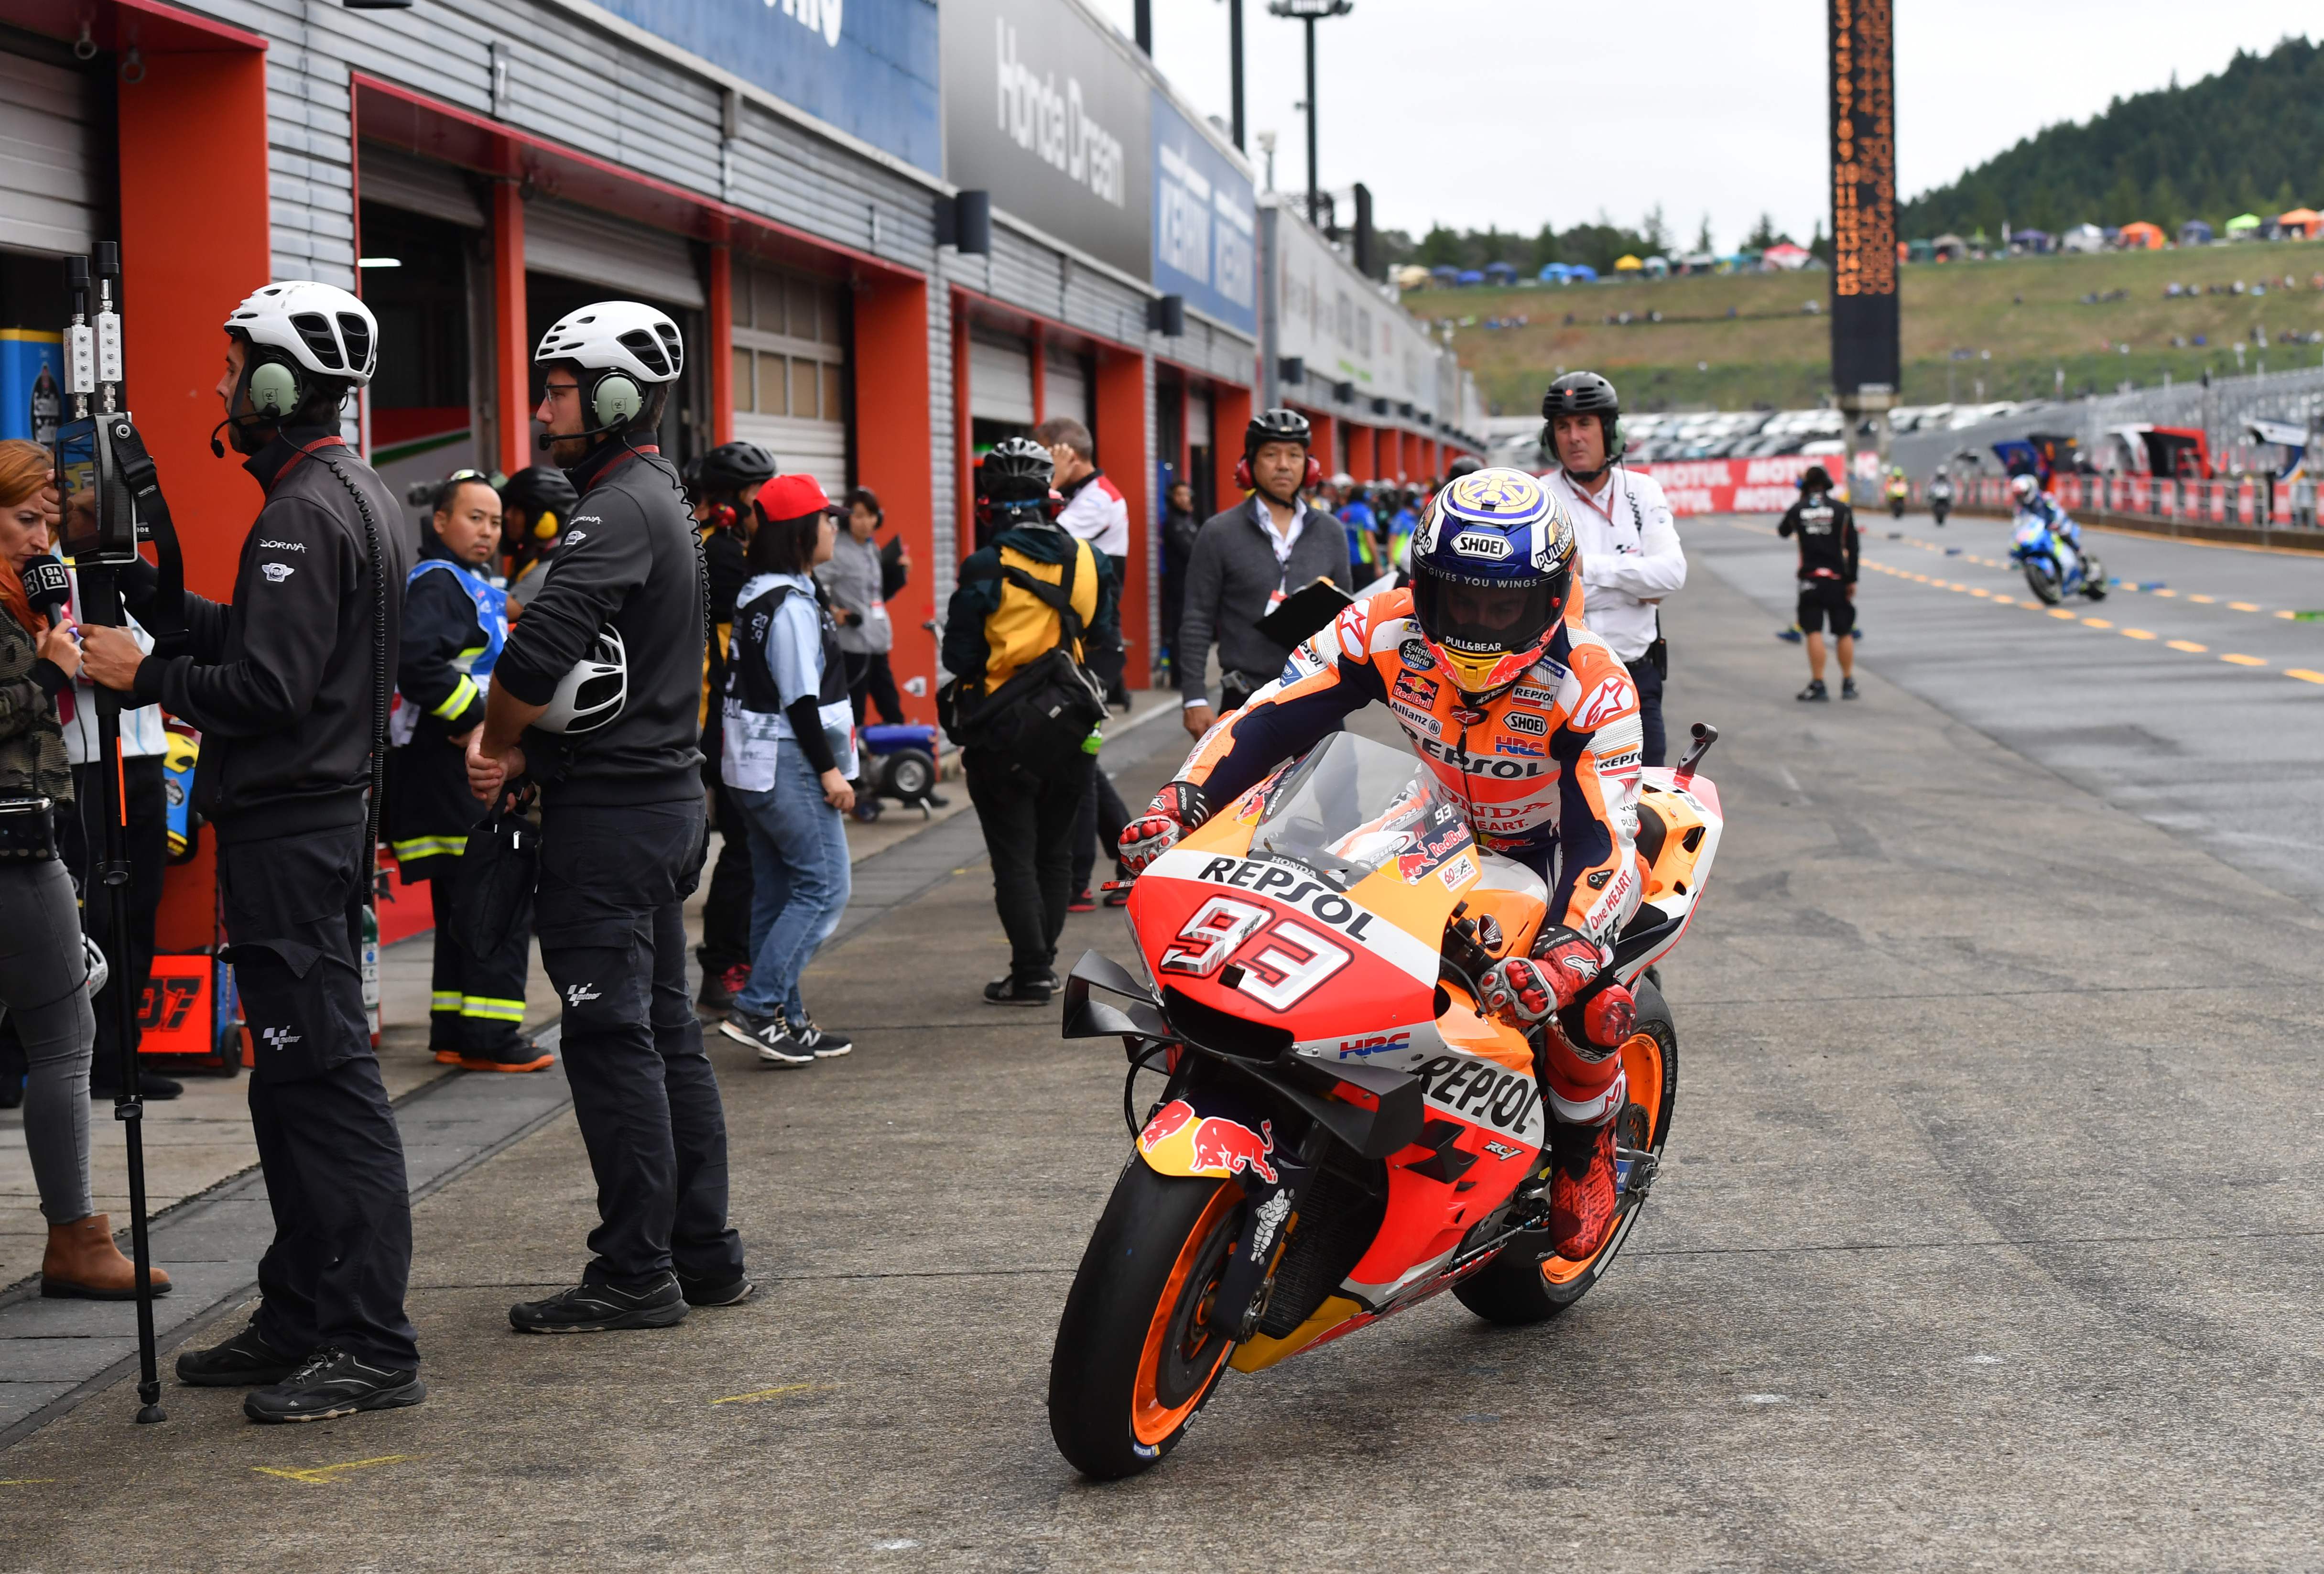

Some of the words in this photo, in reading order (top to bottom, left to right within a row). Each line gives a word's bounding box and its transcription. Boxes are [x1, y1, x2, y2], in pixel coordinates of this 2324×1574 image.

[996, 17, 1066, 172] Honda
[1068, 76, 1125, 210] Dream
[1650, 460, 1731, 487] MOTUL
[259, 538, 308, 554] DORNA
[1459, 537, 1504, 556] SHOEI
[1428, 567, 1457, 583] GIVES
[1464, 576, 1490, 587] YOU
[1497, 578, 1537, 589] WINGS
[1300, 641, 1323, 667] PSOL
[1445, 635, 1502, 652] PULL&BEAR
[1403, 649, 1430, 667] Galicia
[1539, 661, 1563, 675] MICHELIN
[1514, 688, 1554, 702] REPSOL
[1391, 701, 1428, 726] Allianz
[1510, 716, 1544, 733] SHOEI
[1496, 736, 1545, 757] HRC
[1434, 802, 1453, 826] 93
[1269, 855, 1317, 879] HONDA
[1198, 856, 1376, 942] REPSOL
[1590, 908, 1608, 931] One
[1485, 937, 1503, 946] HONDA
[1159, 894, 1355, 1013] 93
[1339, 1031, 1411, 1060] HRC
[1664, 1044, 1673, 1095] MICHELIN
[1407, 1055, 1539, 1135] REPSOL
